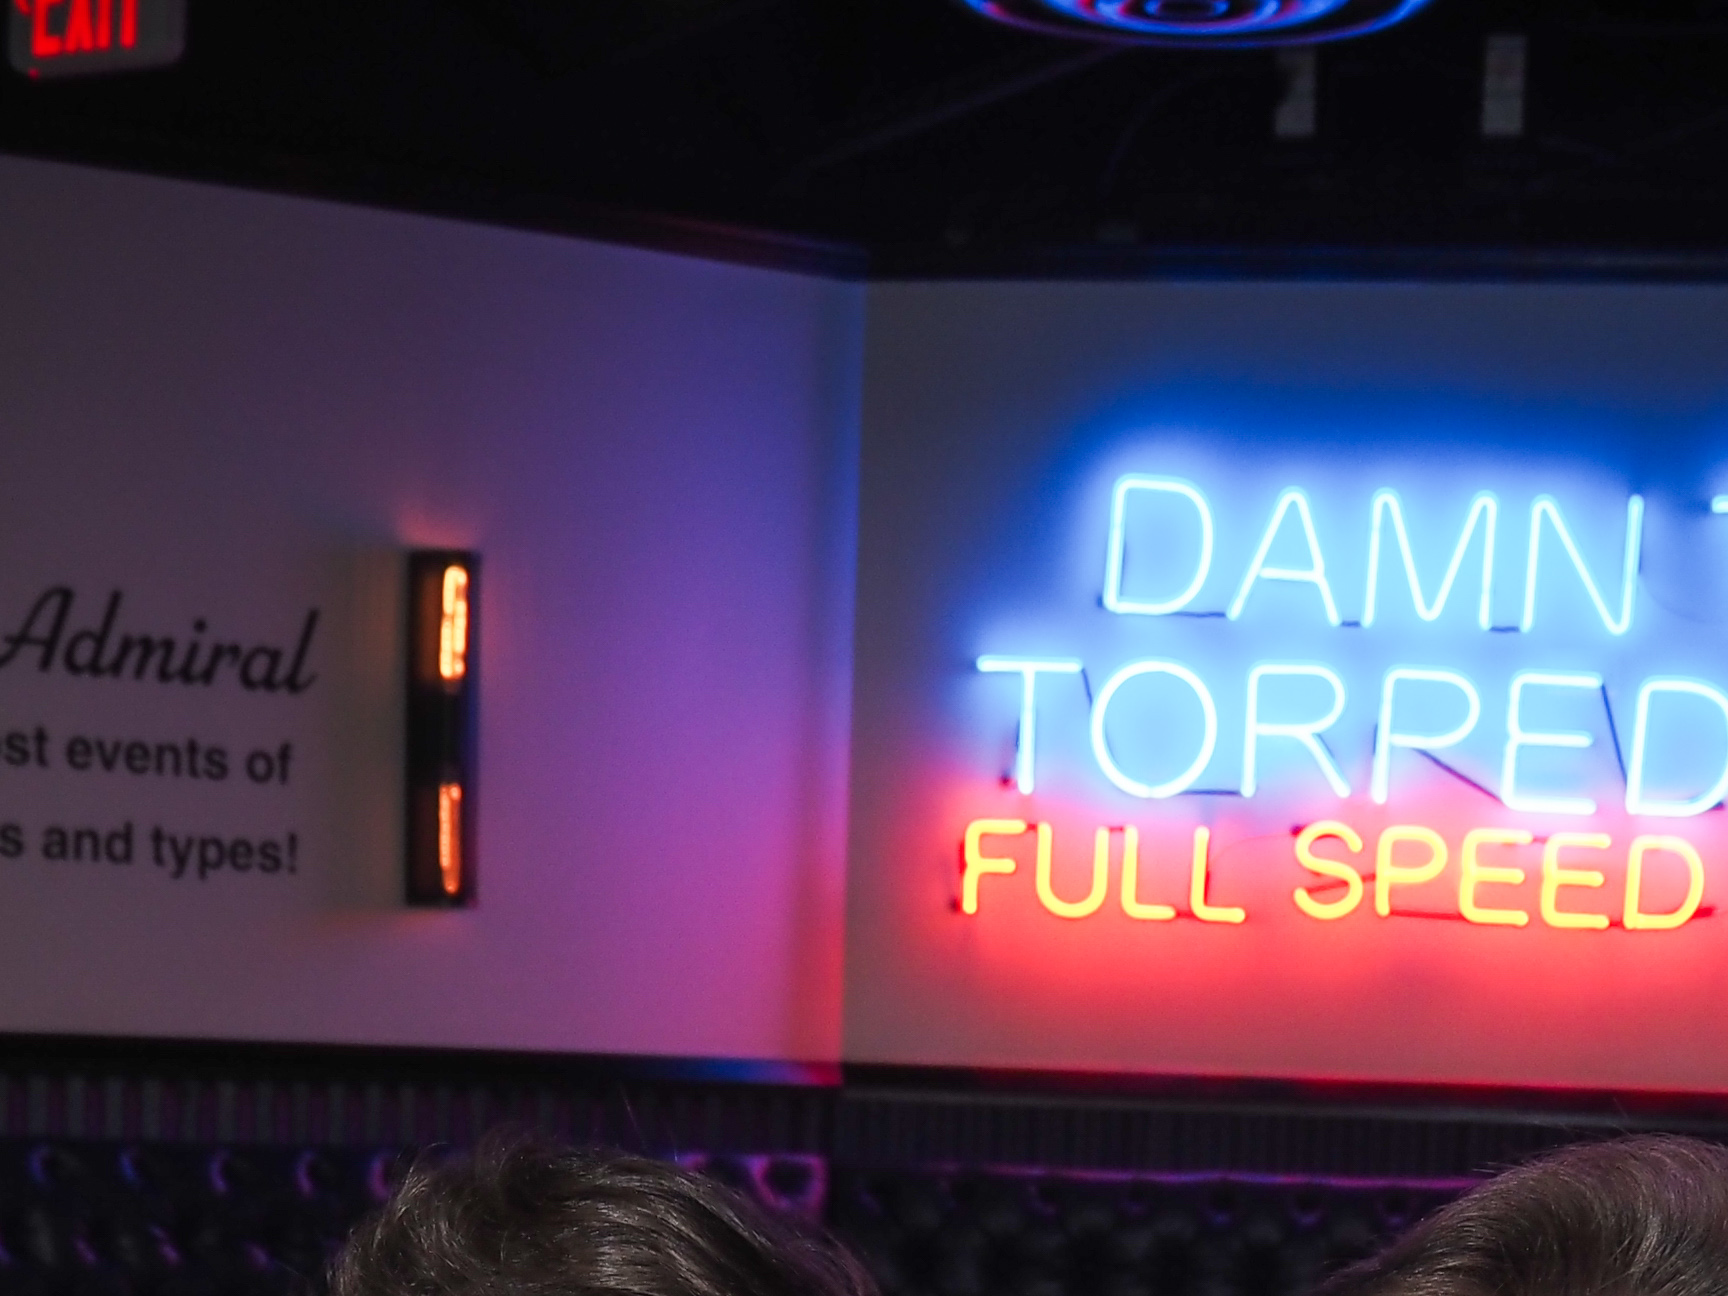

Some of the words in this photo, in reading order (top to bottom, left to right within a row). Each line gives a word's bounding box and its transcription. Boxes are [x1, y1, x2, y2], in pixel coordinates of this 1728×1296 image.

[1102, 474, 1644, 636] DAMN
[65, 731, 228, 780] events
[246, 742, 292, 784] of
[42, 821, 133, 865] and
[151, 825, 299, 880] types!
[962, 819, 1246, 924] FULL
[1292, 819, 1706, 931] SPEED
